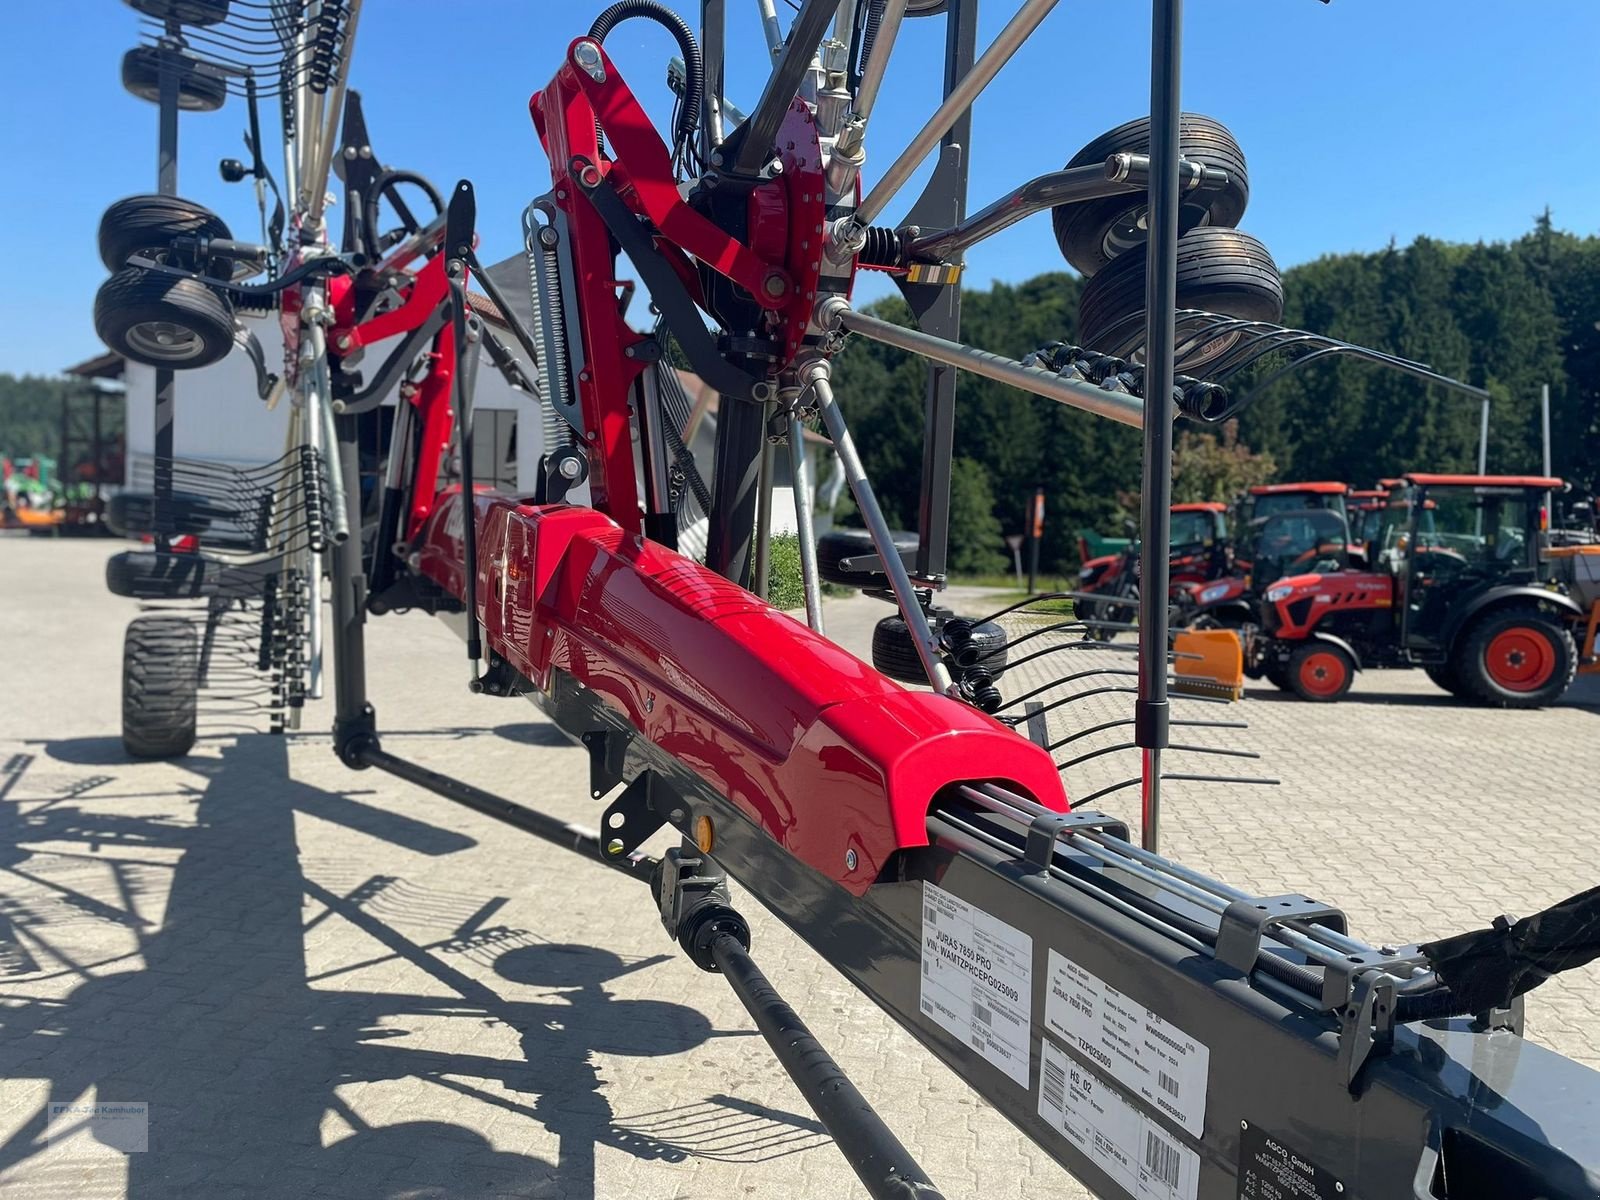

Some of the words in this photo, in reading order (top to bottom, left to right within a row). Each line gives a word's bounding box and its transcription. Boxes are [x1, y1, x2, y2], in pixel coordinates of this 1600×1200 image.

[926, 936, 940, 954] VIN:
[935, 930, 958, 951] JURAS
[959, 943, 975, 961] 7850
[976, 953, 992, 971] PRO
[1081, 1004, 1093, 1018] PRO
[1078, 1036, 1112, 1069] TZP025009
[1265, 1138, 1288, 1158] AGCO
[1291, 1155, 1315, 1176] GmbH
